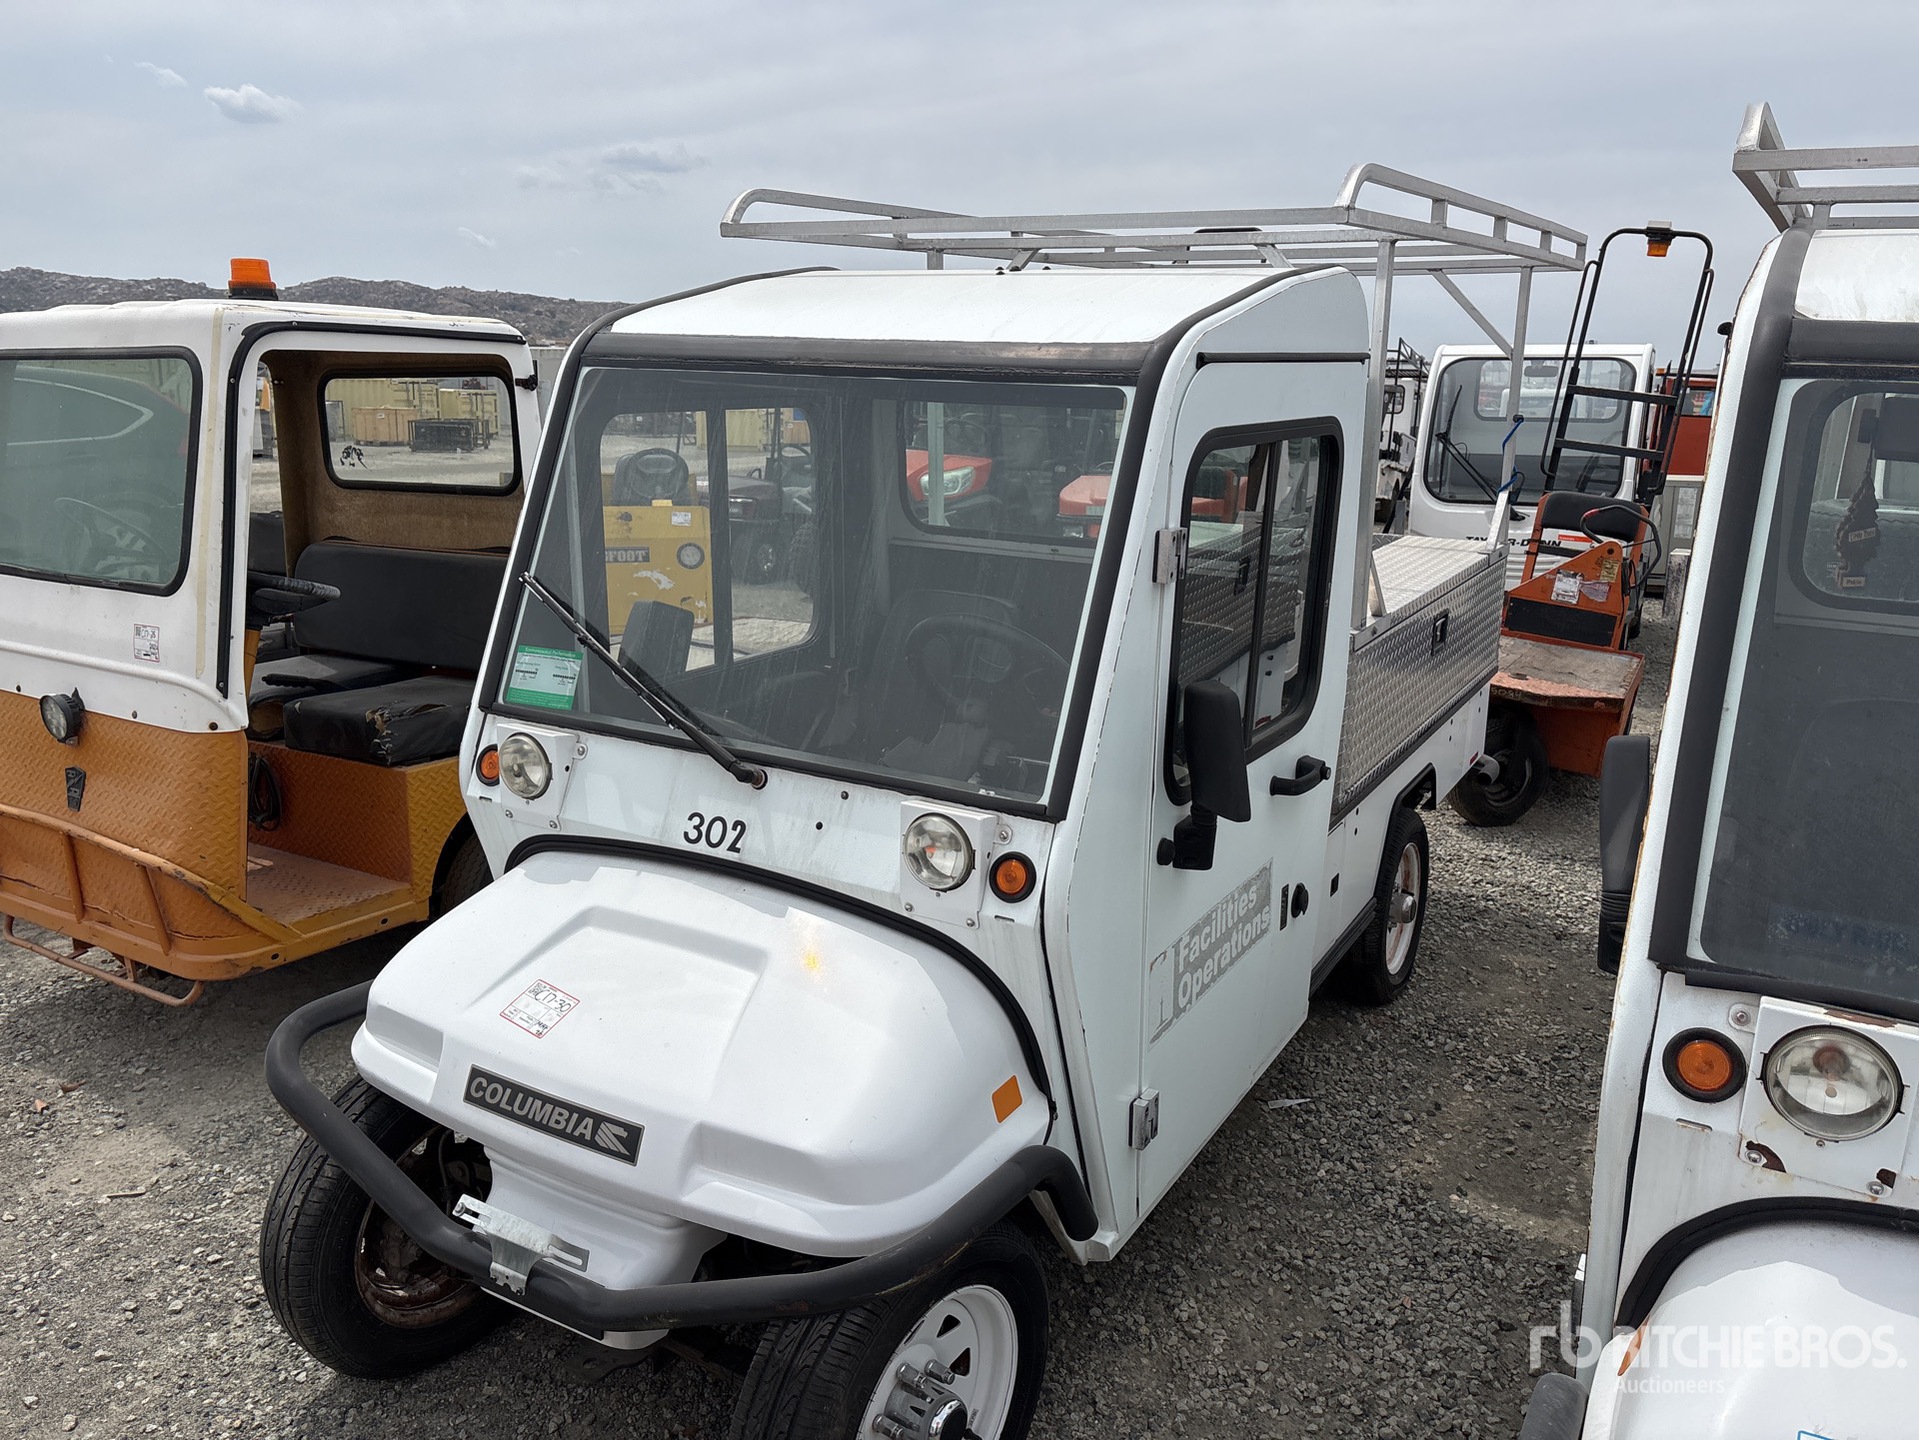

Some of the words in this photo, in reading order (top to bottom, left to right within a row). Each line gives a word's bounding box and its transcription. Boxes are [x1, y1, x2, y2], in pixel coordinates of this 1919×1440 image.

[605, 550, 646, 561] FOOT
[684, 812, 746, 853] 302
[1178, 884, 1257, 974] Facilities
[1178, 905, 1270, 1009] Operations
[470, 1076, 595, 1141] COLUMBIA
